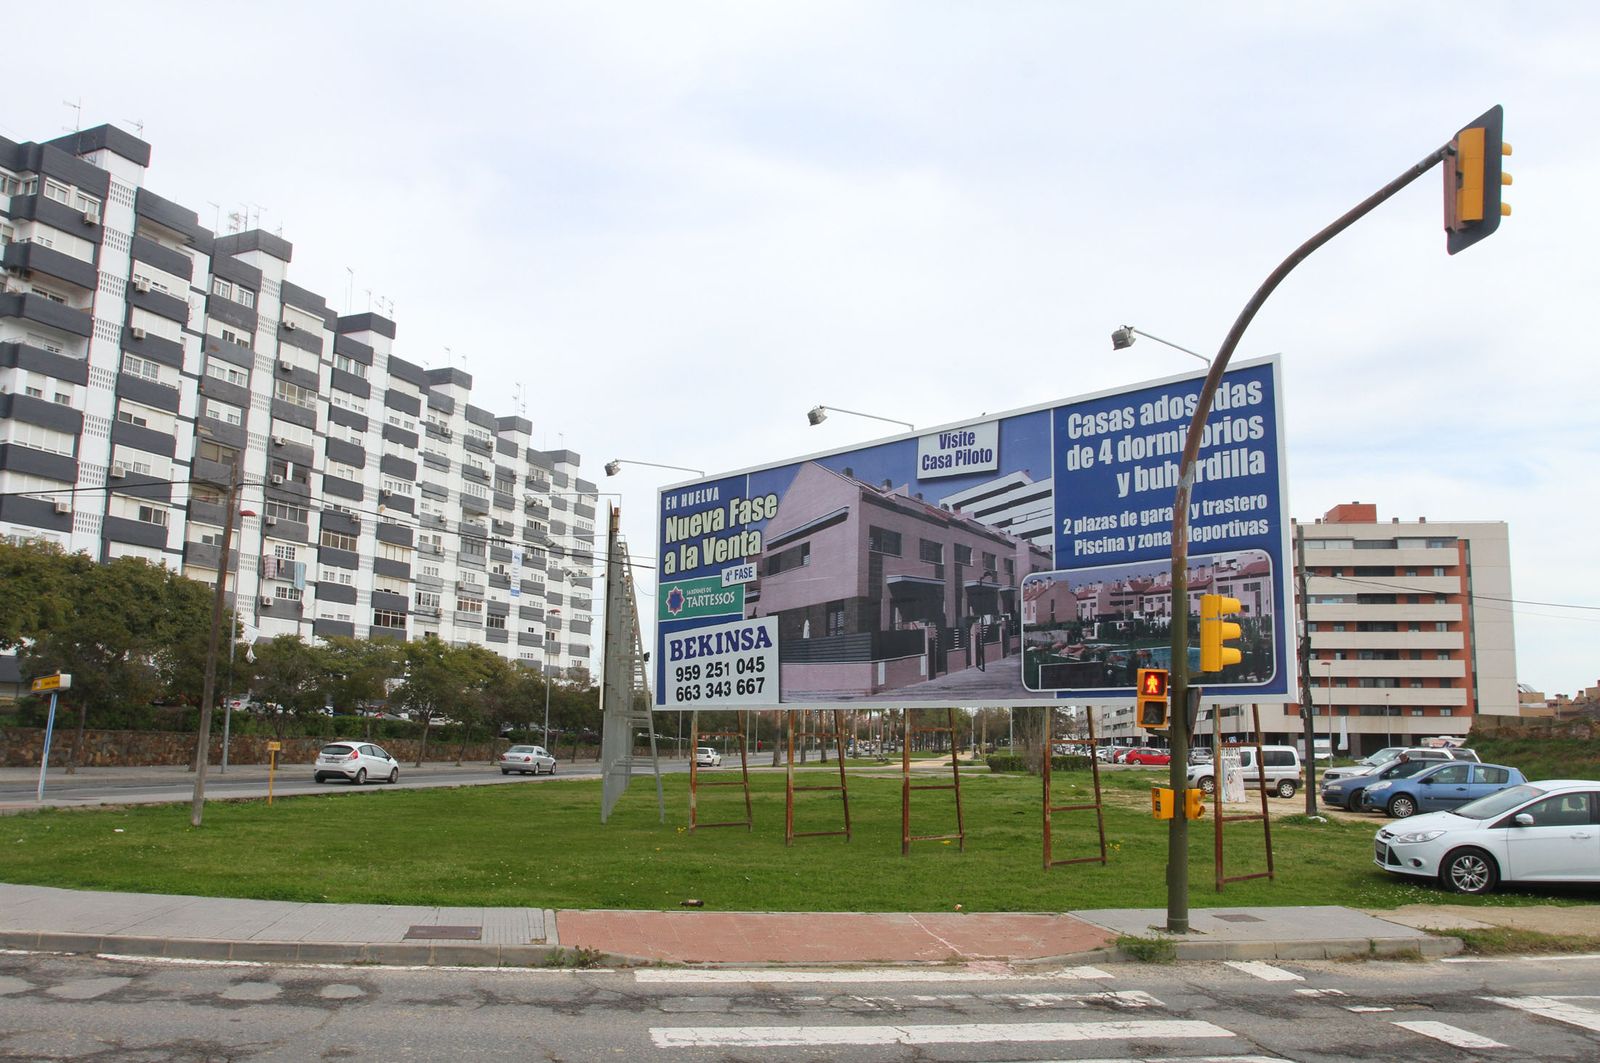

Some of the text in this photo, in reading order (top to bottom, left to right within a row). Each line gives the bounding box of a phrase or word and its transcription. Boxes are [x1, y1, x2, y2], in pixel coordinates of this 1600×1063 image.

[1068, 380, 1263, 439] Casas adosdas
[939, 431, 975, 449] Visite
[1066, 415, 1265, 472] de 4 dormiorios
[922, 447, 993, 471] Casa Piloto
[1116, 447, 1266, 498] y buhrdilla
[665, 486, 720, 511] EN HUELVA
[665, 494, 778, 544] Nueva Fase
[1063, 493, 1268, 535] 2 plazas de gara y trastero
[664, 530, 762, 575] a la Venta
[1074, 535, 1125, 556] Piscina
[1127, 535, 1136, 552] y
[1137, 530, 1173, 549] zona
[734, 566, 753, 580] FASE
[686, 591, 735, 608] TARTESSOS
[670, 625, 772, 661] BEKINSA
[675, 655, 765, 683] 959 251 045
[676, 677, 766, 702] 663 343 667
